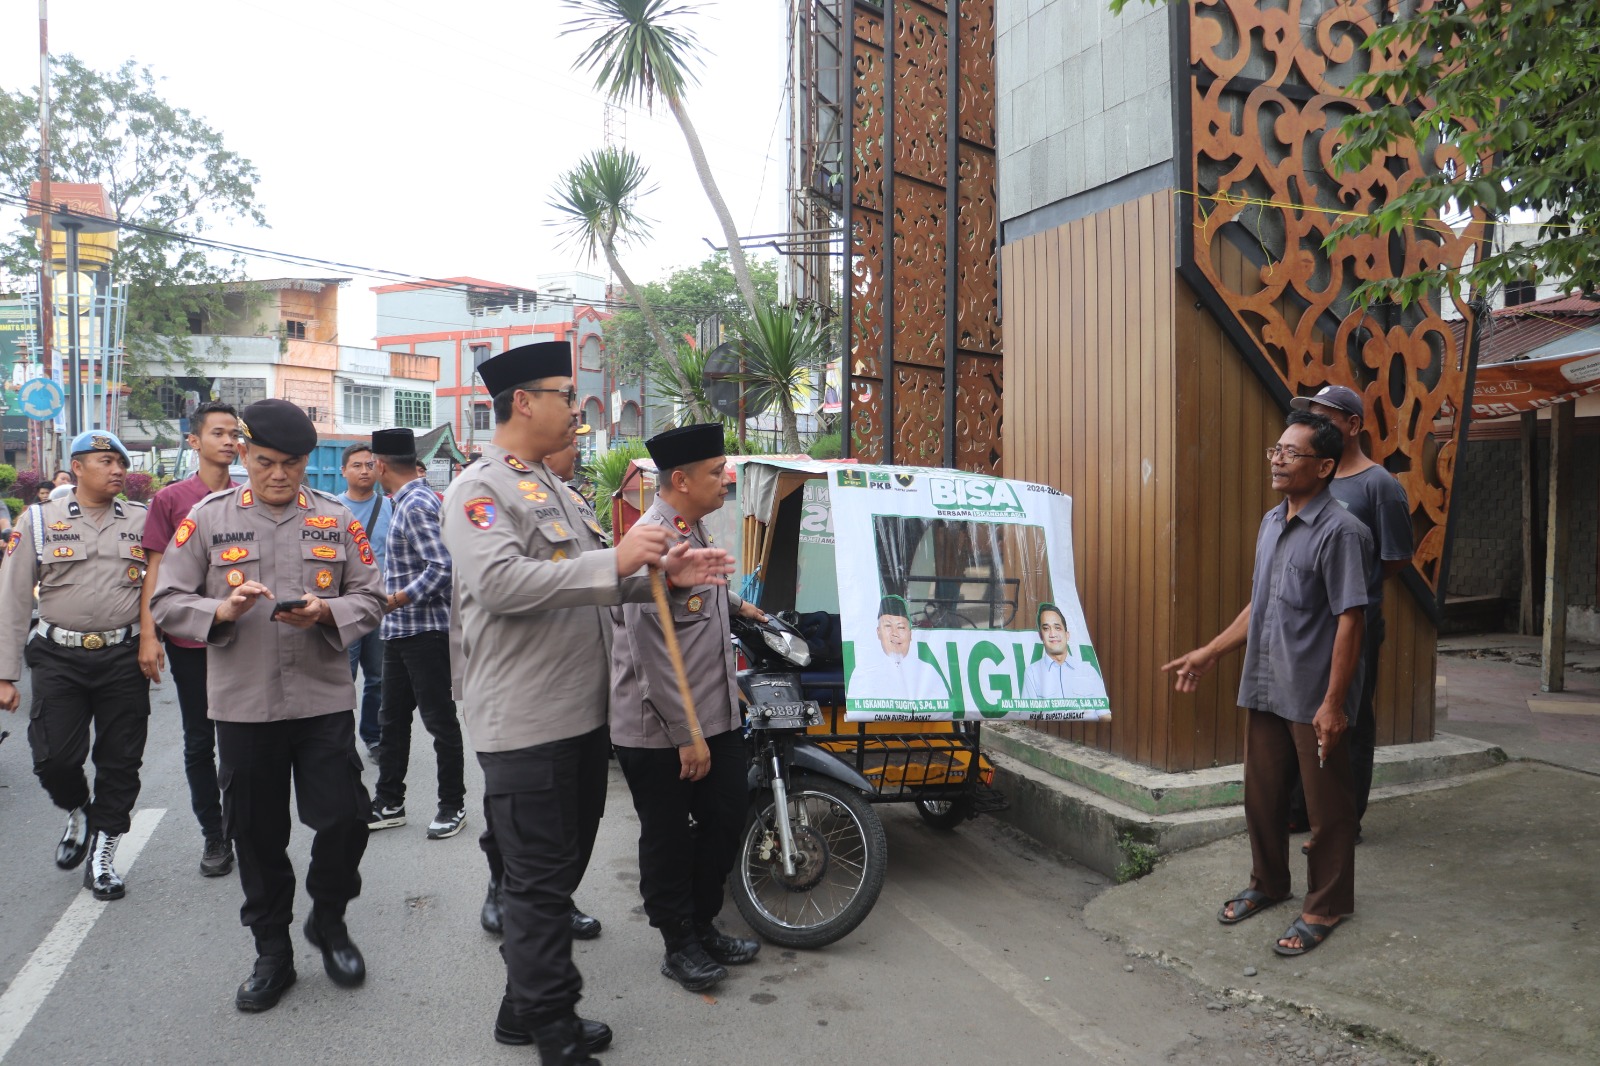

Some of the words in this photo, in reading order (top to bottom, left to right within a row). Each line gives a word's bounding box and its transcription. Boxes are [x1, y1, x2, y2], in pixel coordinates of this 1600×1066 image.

[1499, 382, 1517, 391] 147
[870, 482, 892, 490] PKB
[1026, 484, 1065, 496] 2024-202
[930, 478, 1024, 511] BISA
[536, 508, 560, 519] DAVID
[52, 534, 80, 542] SIAGIAN
[302, 530, 340, 542] POLRI
[863, 700, 894, 708] ISKANDAR
[895, 701, 918, 711] SUGITO,
[1014, 700, 1029, 708] TAMA
